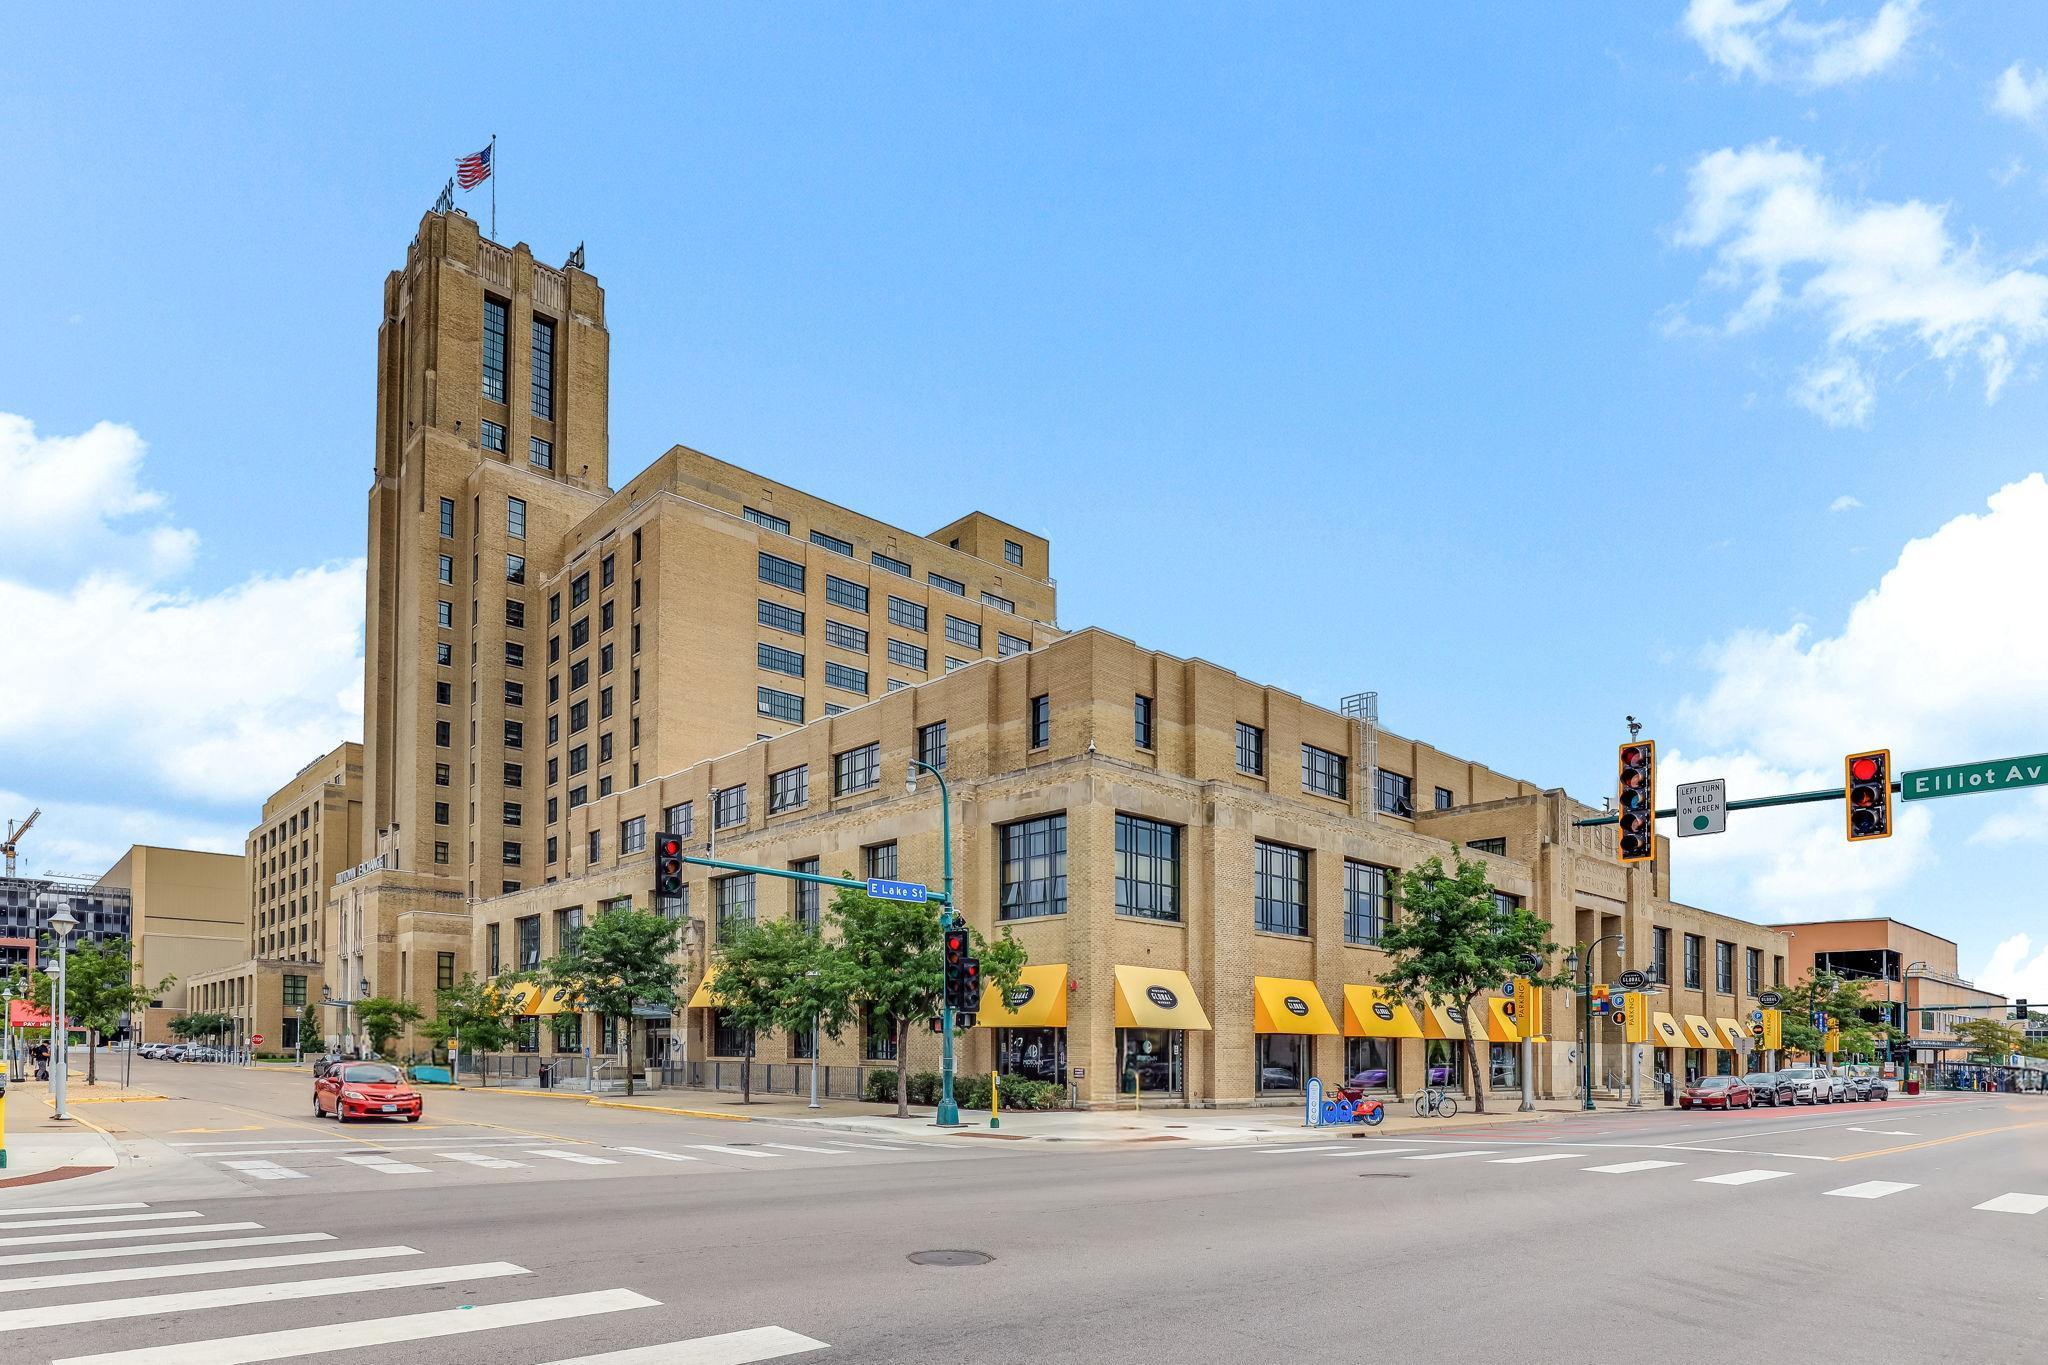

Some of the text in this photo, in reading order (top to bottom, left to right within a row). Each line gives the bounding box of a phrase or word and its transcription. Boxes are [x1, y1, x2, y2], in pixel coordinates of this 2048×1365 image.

[1916, 765, 2042, 793] Elliot Av
[1681, 784, 1720, 796] LEFT TURN
[1689, 794, 1713, 805] YIELD
[1682, 804, 1720, 815] ON GREEN
[871, 883, 923, 898] E Lake St
[1151, 993, 1173, 1001] GLOBAL
